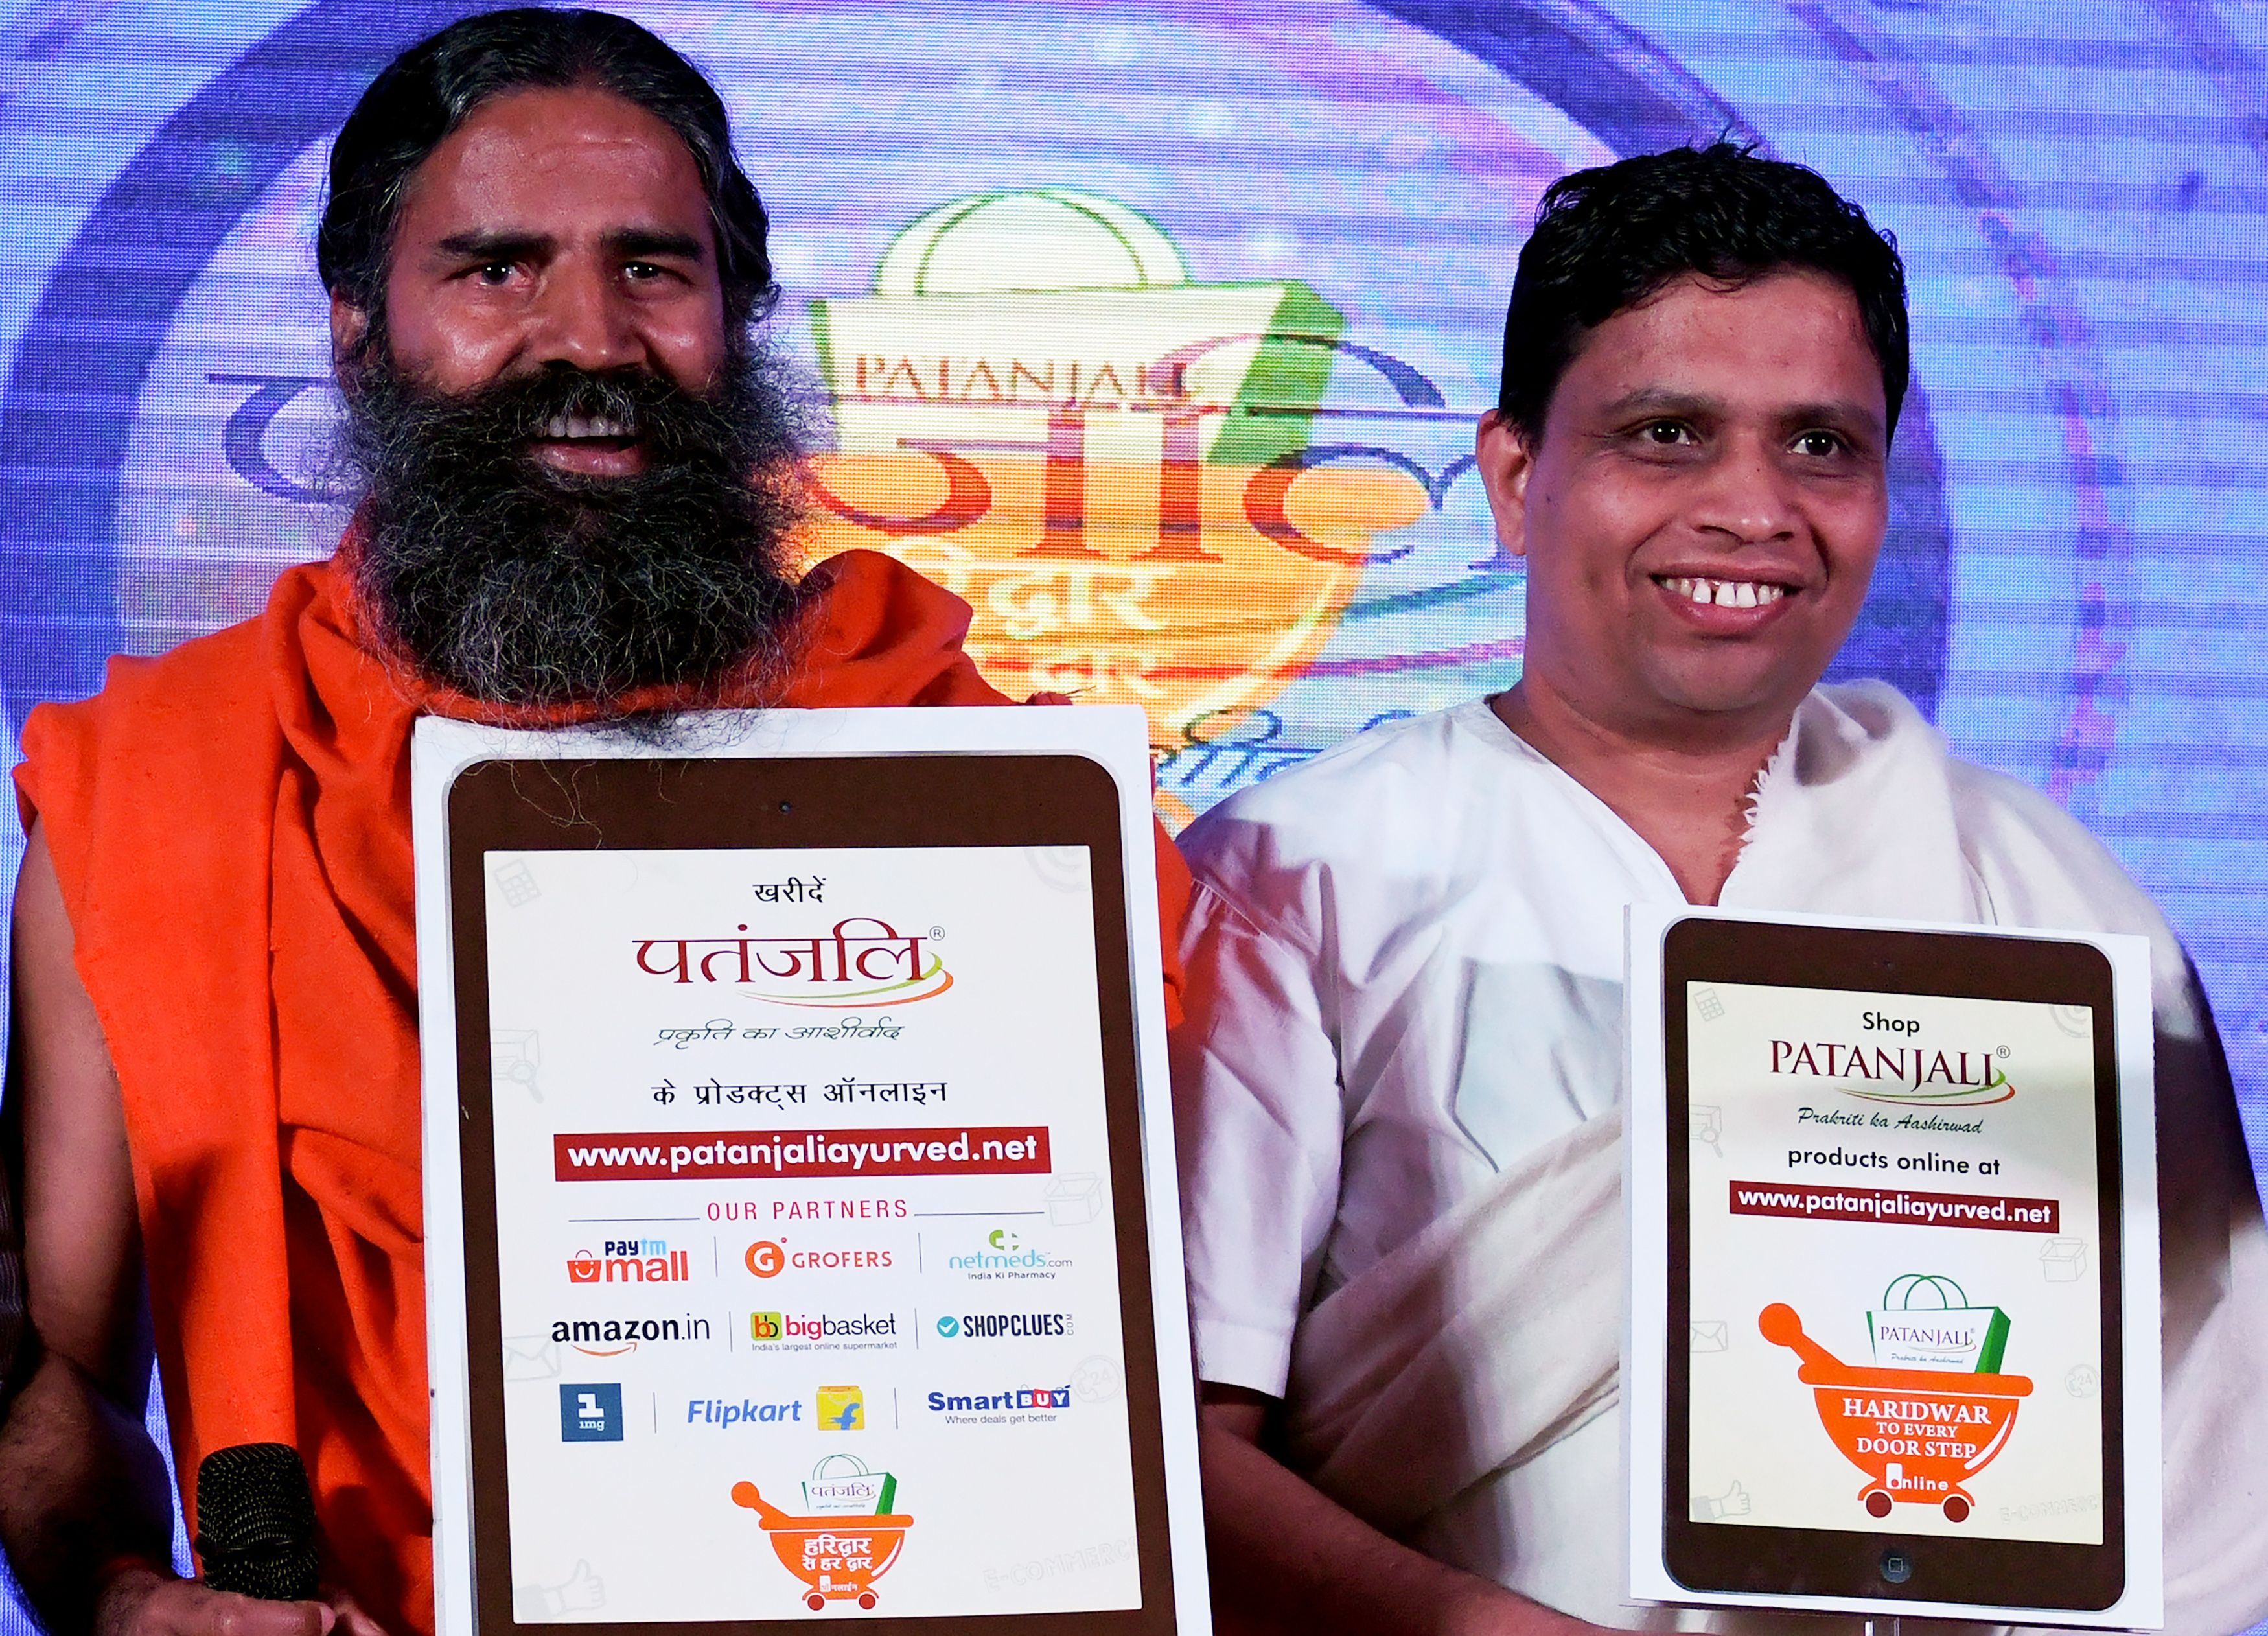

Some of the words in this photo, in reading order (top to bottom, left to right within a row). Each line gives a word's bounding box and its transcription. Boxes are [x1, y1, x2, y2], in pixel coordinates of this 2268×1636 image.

[752, 875, 827, 903] खरीदें
[653, 1018, 737, 1050] प्रकृति
[742, 1027, 780, 1040] का
[784, 1016, 905, 1041] आशीर्वाद
[1862, 1011, 1921, 1037] Shop
[1768, 1039, 1994, 1093] PATANJALI
[651, 1078, 677, 1105] के
[693, 1077, 808, 1111] प्रोडक्ट्स
[823, 1077, 949, 1106] ऑनलाइन
[1798, 1106, 1865, 1127] Prakriti
[1869, 1112, 1890, 1128] ka
[1893, 1113, 1984, 1134] Aashirwad
[567, 1132, 1038, 1173] www.patanjaliayurved.net
[1787, 1146, 1889, 1169] products
[1897, 1152, 1970, 1174] online
[1978, 1158, 2001, 1176] at
[706, 1202, 758, 1222] OUR
[773, 1199, 908, 1221] PARTNERS
[1737, 1187, 2052, 1224] www.patanjaliayurved.net
[605, 1250, 689, 1283] mall
[791, 1250, 893, 1268] GROFERS
[968, 1272, 992, 1280] India
[1008, 1271, 1056, 1280] Pharmacy
[551, 1313, 710, 1343] amazon.in
[785, 1313, 897, 1340] bigbasket
[963, 1314, 1065, 1337] SHOPCLUES
[1880, 1326, 1969, 1346] PATANJALI
[752, 1343, 780, 1351] India's
[782, 1342, 812, 1353] largest
[842, 1341, 897, 1351] supermarket
[687, 1399, 802, 1429] Flipkart
[945, 1415, 978, 1425] Where
[980, 1414, 1007, 1424] deals
[1010, 1415, 1025, 1425] get
[1028, 1414, 1058, 1423] better
[1842, 1397, 1993, 1425] HARIDWAR
[1875, 1421, 1901, 1435] TO
[1903, 1423, 1958, 1438] EVERY
[1856, 1437, 1922, 1456] DOOR
[1924, 1440, 1977, 1459] STEP
[811, 1482, 870, 1497] पतंजलि
[804, 1534, 872, 1558] हरिद्वार
[801, 1554, 816, 1570] से
[820, 1557, 842, 1571] हर
[846, 1556, 874, 1572] द्वार
